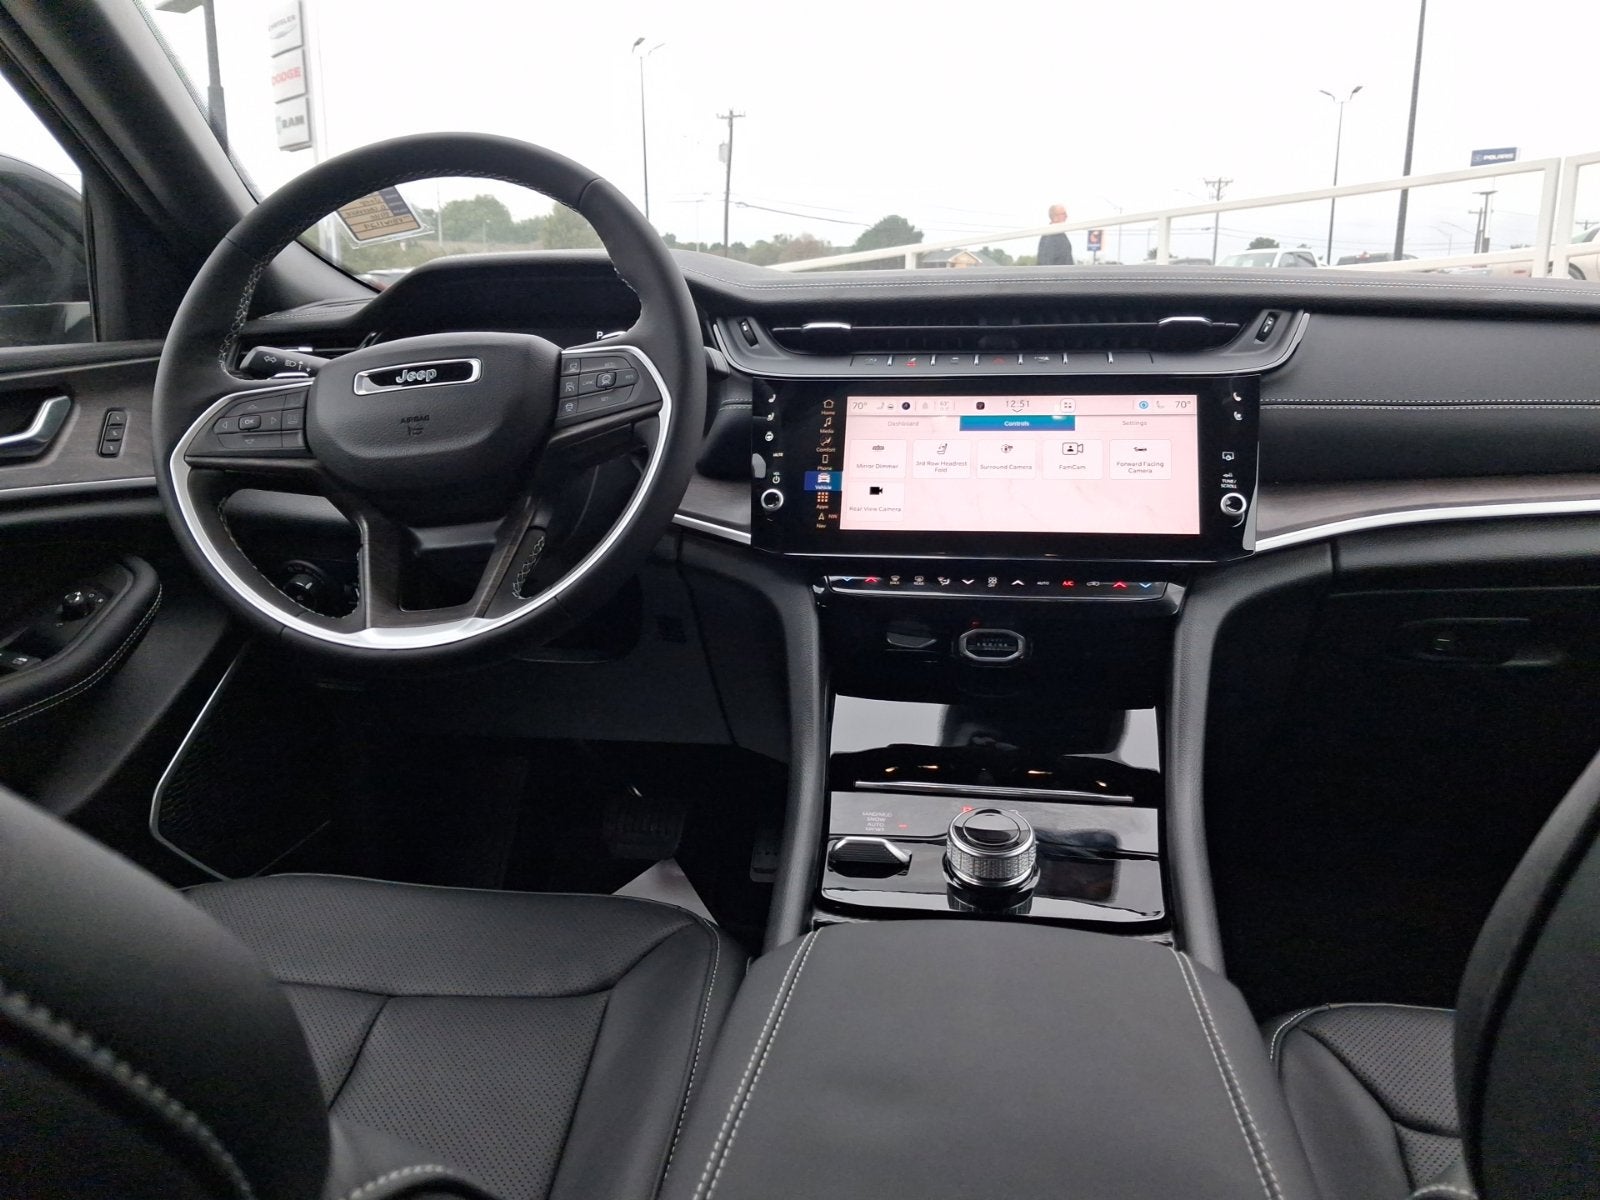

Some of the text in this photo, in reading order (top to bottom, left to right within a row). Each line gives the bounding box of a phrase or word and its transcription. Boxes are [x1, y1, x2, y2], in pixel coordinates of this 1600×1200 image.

[271, 66, 301, 86] DODGE
[281, 114, 305, 128] RAM
[596, 331, 604, 339] P
[395, 369, 437, 383] Jeep
[852, 401, 868, 410] 70°
[1005, 399, 1030, 408] 12:51
[1175, 400, 1191, 409] 70°
